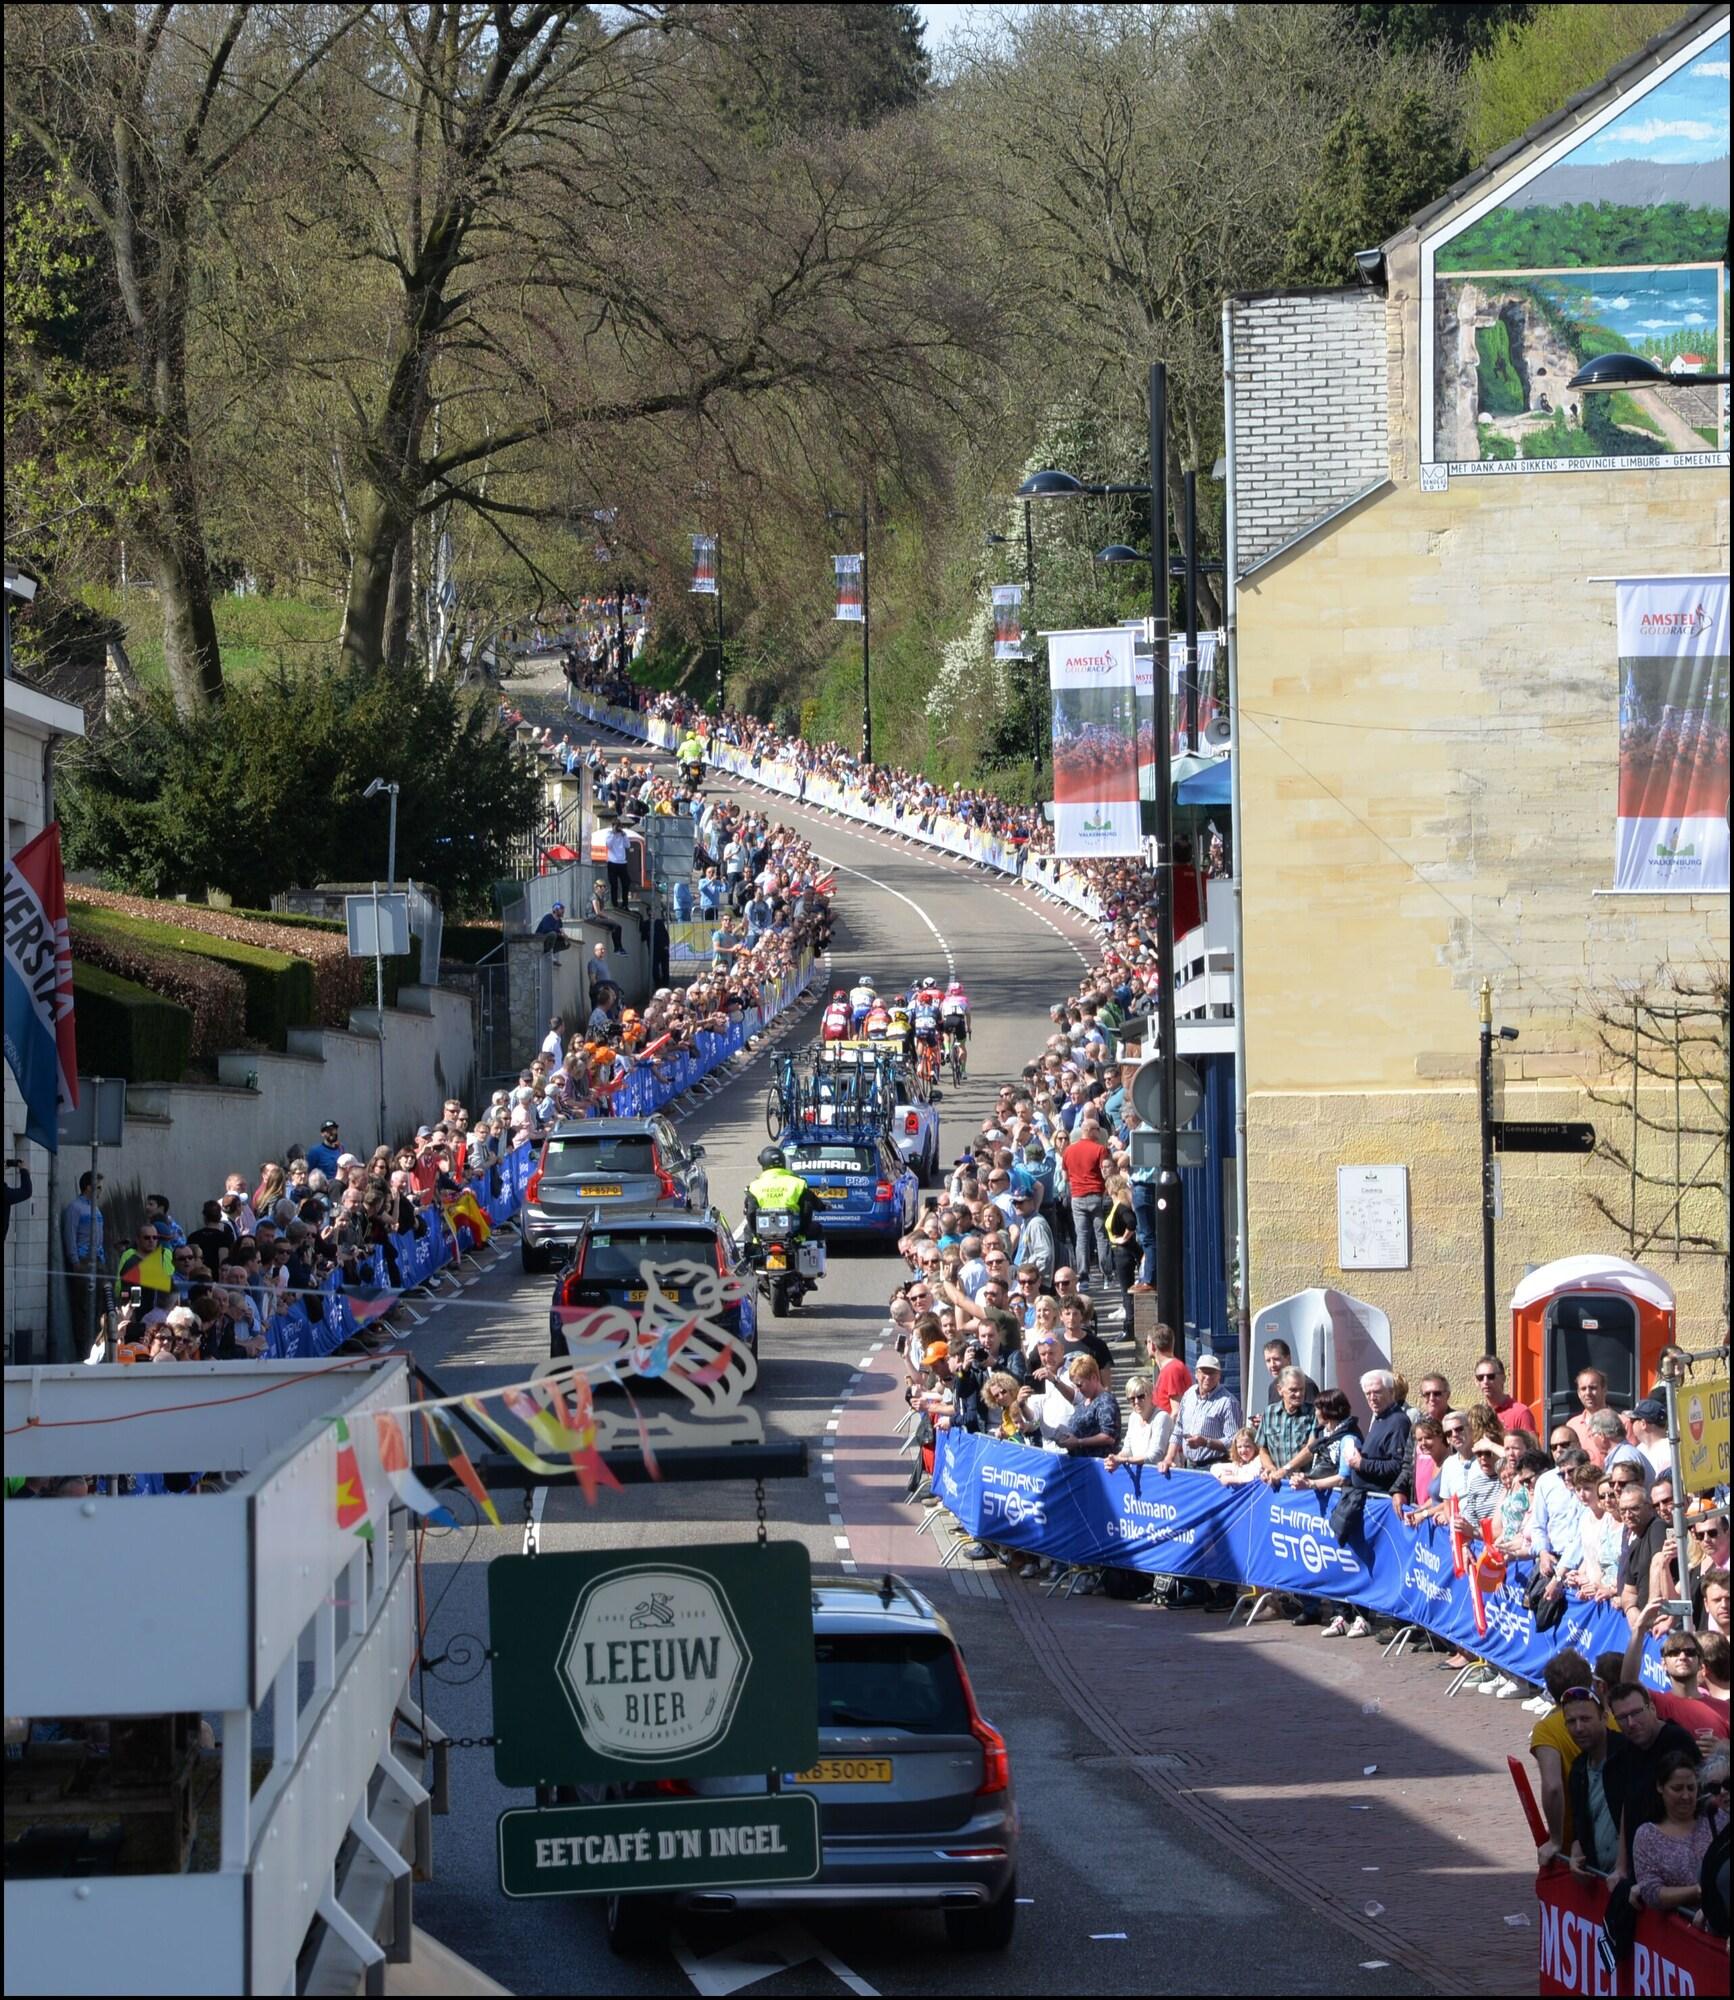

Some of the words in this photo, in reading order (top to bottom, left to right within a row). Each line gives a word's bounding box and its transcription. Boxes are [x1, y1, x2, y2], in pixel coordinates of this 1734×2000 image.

[1451, 462, 1467, 473] MET
[1471, 462, 1494, 473] DANK
[1498, 461, 1517, 472] AAN
[1521, 460, 1558, 471] SIKKENS
[1568, 458, 1616, 469] PROVINCIE
[1620, 456, 1660, 467] LIMBURG
[1673, 454, 1721, 466] GEMEENTE
[1641, 613, 1696, 626] AMSTEL
[1065, 657, 1106, 668] AMSTEL
[1648, 858, 1702, 866] VALKENBURG
[791, 1160, 861, 1171] SHIMANO
[981, 1465, 1047, 1495] SHIMANO
[1123, 1492, 1177, 1522] Shimano
[1107, 1517, 1145, 1541] e-Bike
[1270, 1504, 1336, 1538] SHIMAN
[583, 1636, 720, 1686] LEEUW
[625, 1691, 686, 1727] BIER
[535, 1828, 653, 1868] EETCAFÉ
[709, 1824, 788, 1857] INGEL
